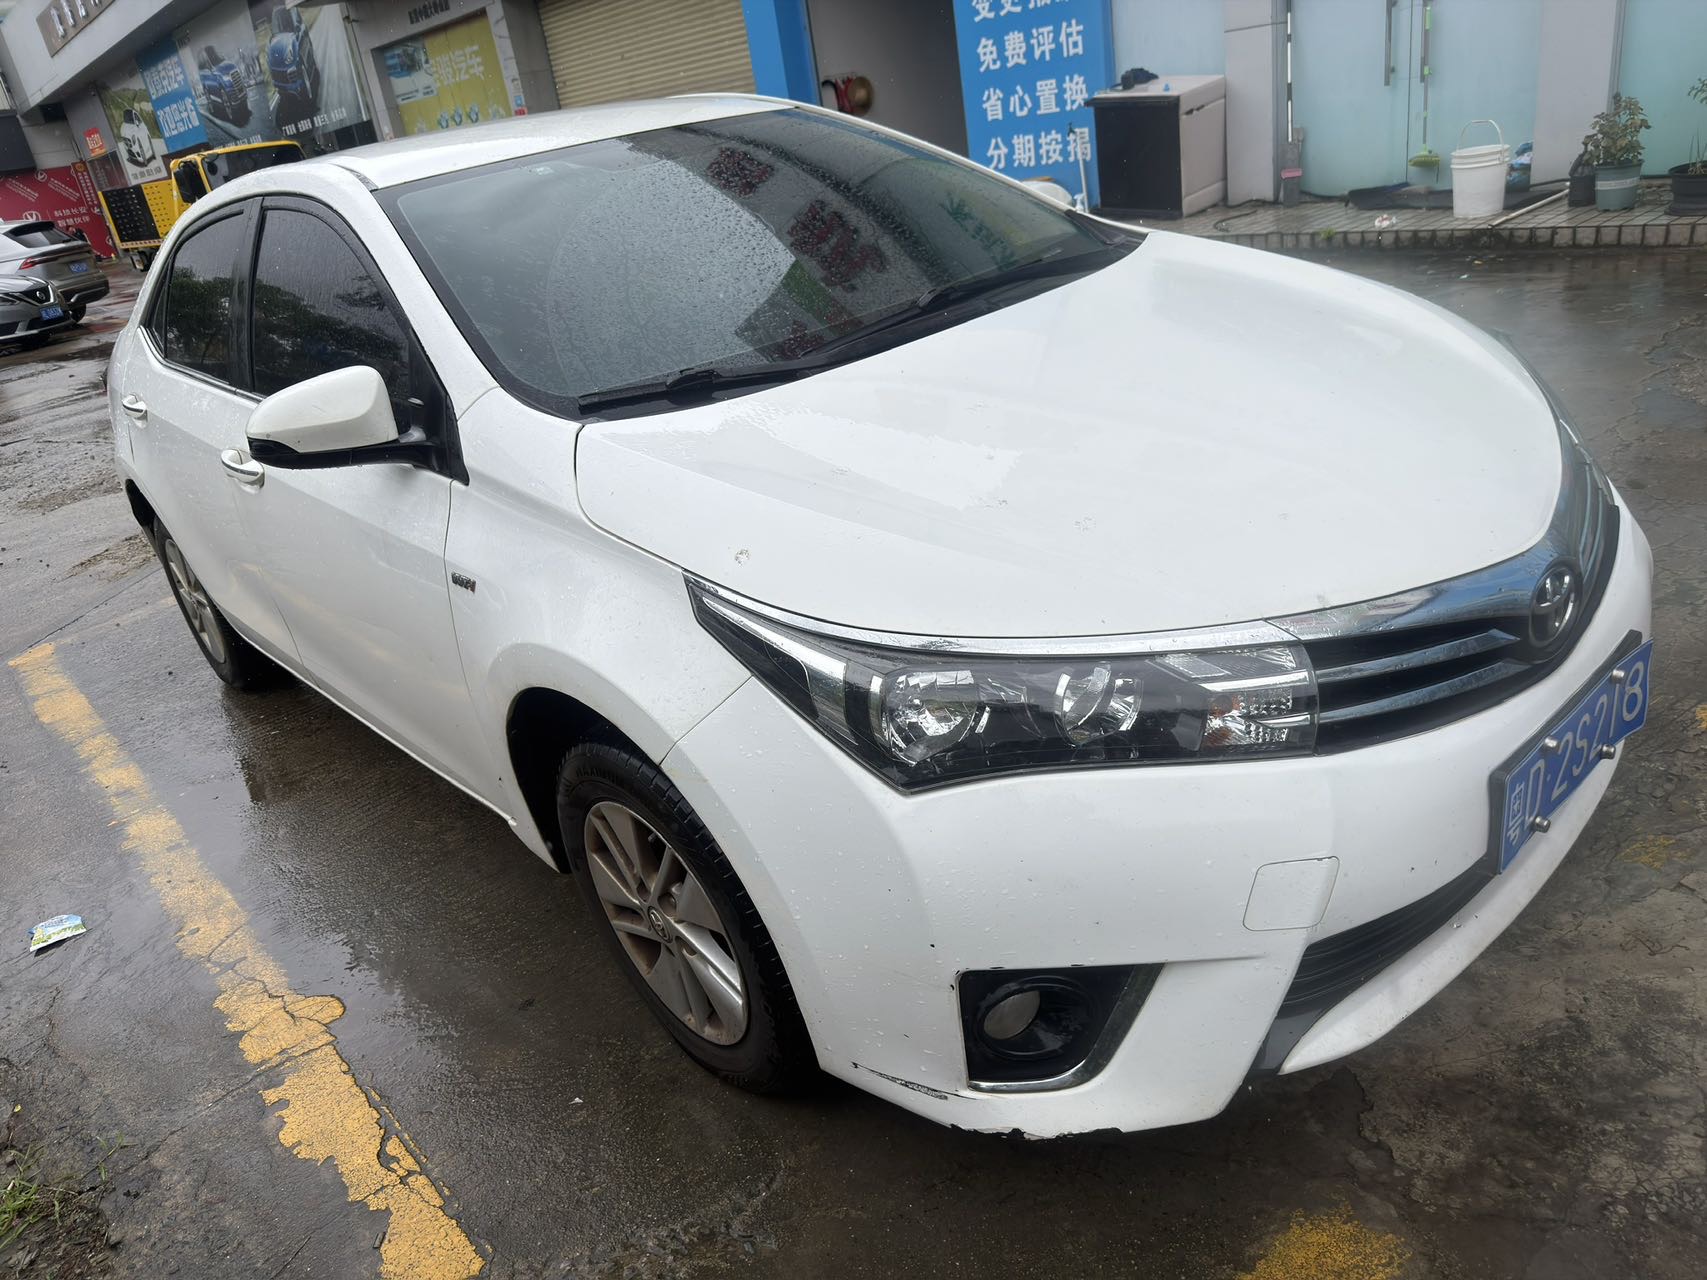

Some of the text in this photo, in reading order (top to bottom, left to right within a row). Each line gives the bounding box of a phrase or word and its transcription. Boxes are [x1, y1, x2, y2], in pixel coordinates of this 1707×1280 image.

[976, 18, 1084, 72] 免费评估
[981, 73, 1089, 122] 省心置换
[986, 127, 1092, 169] 分期按揭
